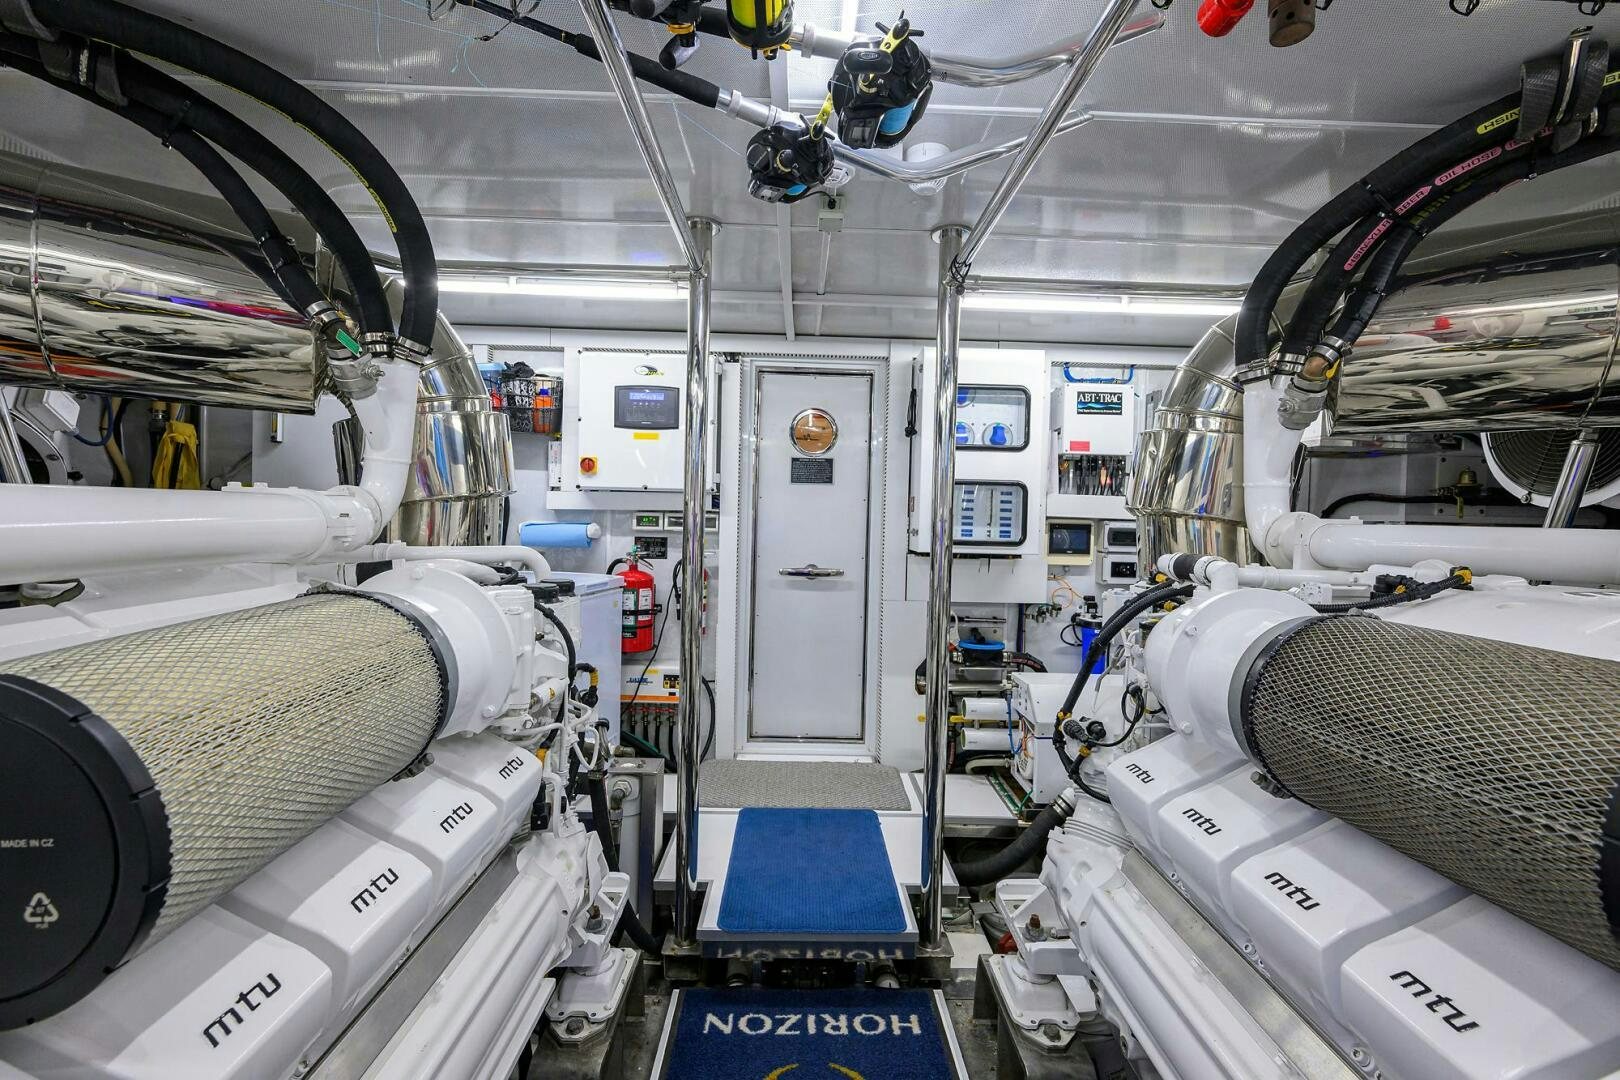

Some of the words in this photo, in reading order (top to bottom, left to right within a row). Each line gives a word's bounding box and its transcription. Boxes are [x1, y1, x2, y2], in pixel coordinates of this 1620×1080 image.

[1438, 169, 1459, 184] OIL
[1461, 148, 1500, 171] HOSE
[1381, 190, 1426, 228] RBBER
[498, 756, 524, 780] mtu
[1125, 763, 1154, 784] mtu
[439, 802, 474, 834] mtu
[1182, 808, 1222, 836] mtu
[0, 840, 28, 848] MADE
[29, 839, 39, 847] IN
[41, 838, 54, 847] CZ
[350, 867, 399, 913] mtu
[1264, 872, 1321, 911] mtu
[203, 973, 282, 1048] mtu
[1389, 970, 1480, 1033] mtu
[702, 1012, 922, 1036] HORIZON
